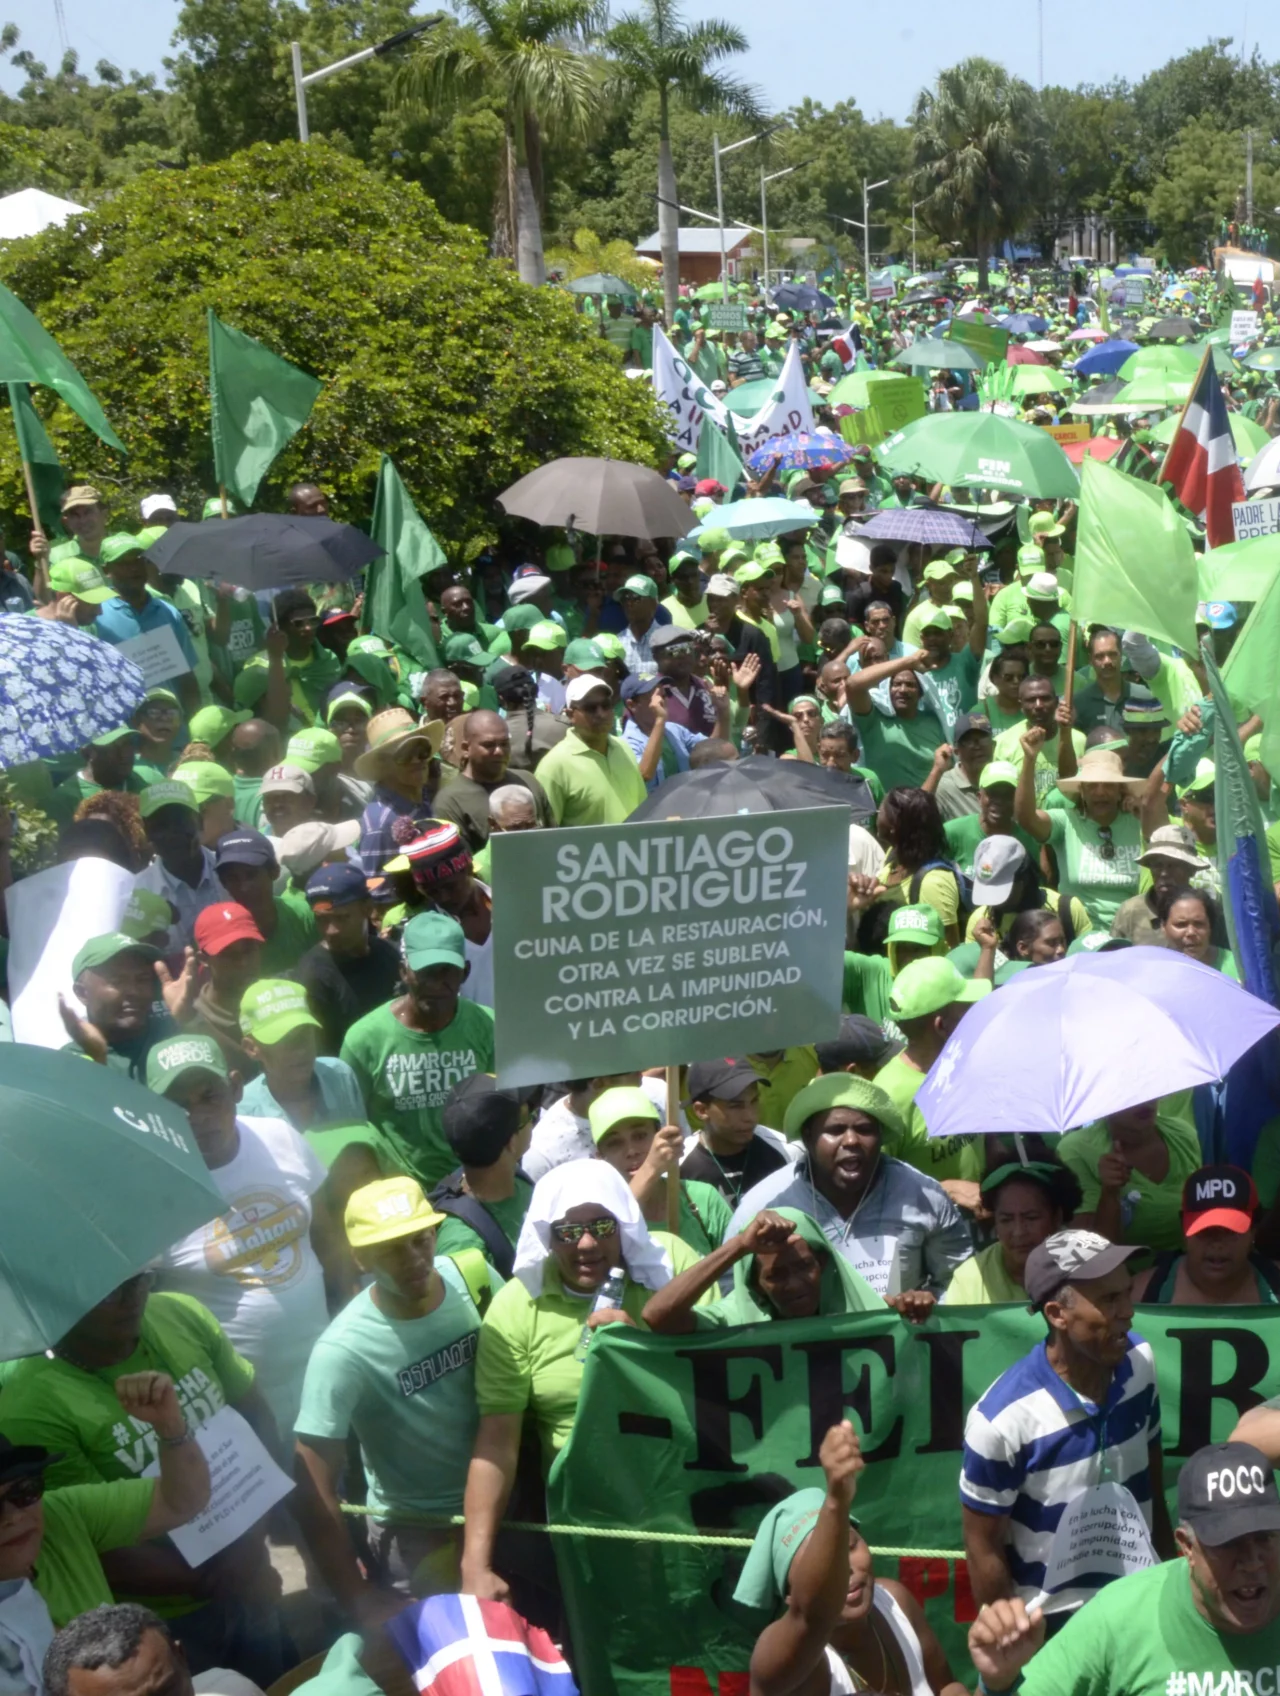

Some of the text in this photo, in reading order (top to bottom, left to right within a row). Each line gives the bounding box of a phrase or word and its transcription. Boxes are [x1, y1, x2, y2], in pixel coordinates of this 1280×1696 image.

[978, 458, 1011, 473] FIN
[1233, 504, 1265, 527] PADRE
[271, 767, 284, 780] H
[556, 827, 794, 884] SANTIAGO
[542, 862, 808, 924] RODRIGUEZ
[514, 905, 828, 960] CUNA DE LA RESTAURACIÓN,
[894, 917, 929, 931] VERDE
[558, 940, 790, 984] OTRA VEZ SE SUBLEVA
[544, 966, 802, 1015] CONTRA LA IMPUNIDAD
[568, 994, 779, 1040] Y LA CORRUPCIÓN.
[158, 1050, 214, 1070] VERDE
[386, 1049, 477, 1073] #MARCHA
[931, 1147, 945, 1163] LA
[1196, 1178, 1237, 1202] MPD
[1207, 1465, 1266, 1501] FOCO
[213, 1509, 231, 1525] PLD
[1069, 1504, 1117, 1526] En la lucha
[1071, 1520, 1145, 1539] la corrupción y
[1069, 1534, 1138, 1551] la impunidad,
[1091, 1548, 1103, 1556] se
[1106, 1549, 1152, 1568] cansa!!!
